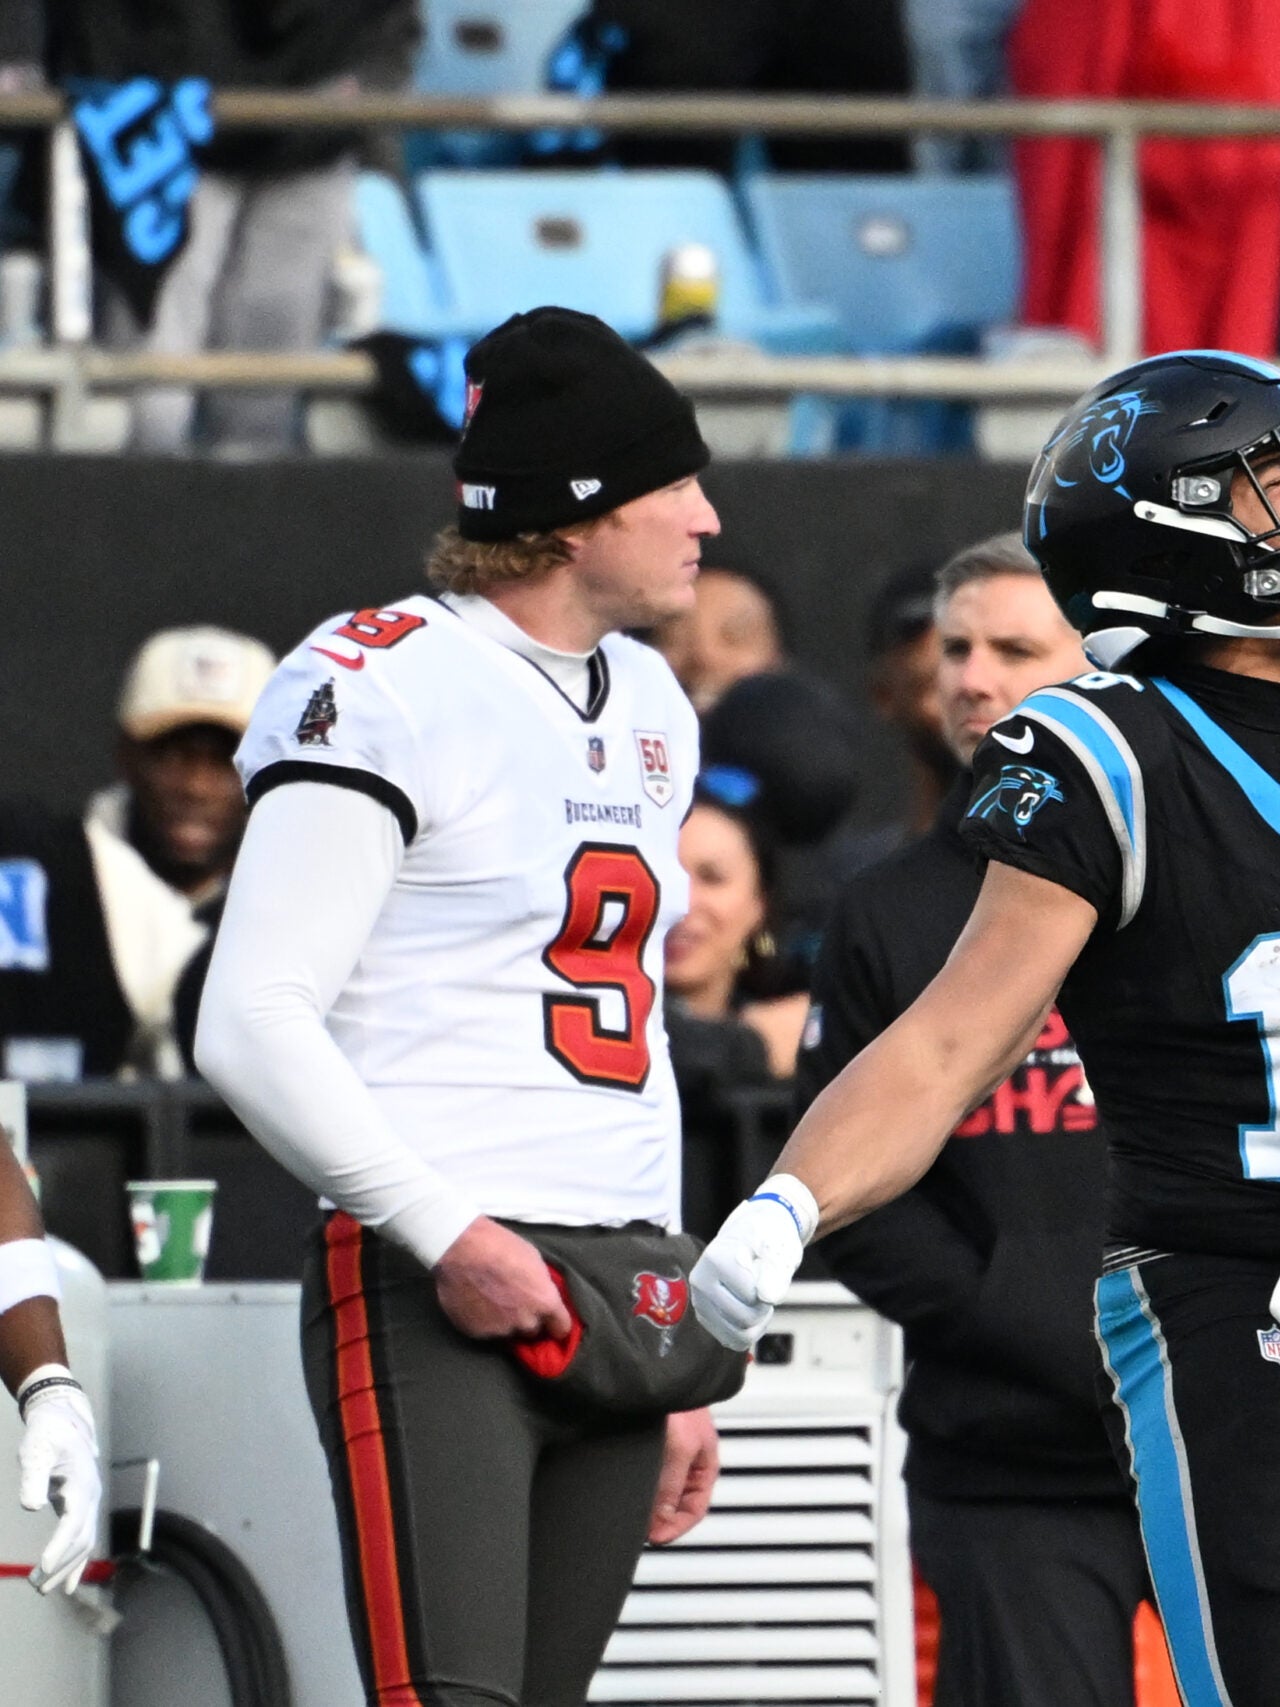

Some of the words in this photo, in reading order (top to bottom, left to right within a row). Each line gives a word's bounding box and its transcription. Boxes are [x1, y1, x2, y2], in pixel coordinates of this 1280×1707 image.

[640, 738, 667, 773] 50
[565, 799, 641, 828] BUCCANEERS
[542, 841, 660, 1093] 9
